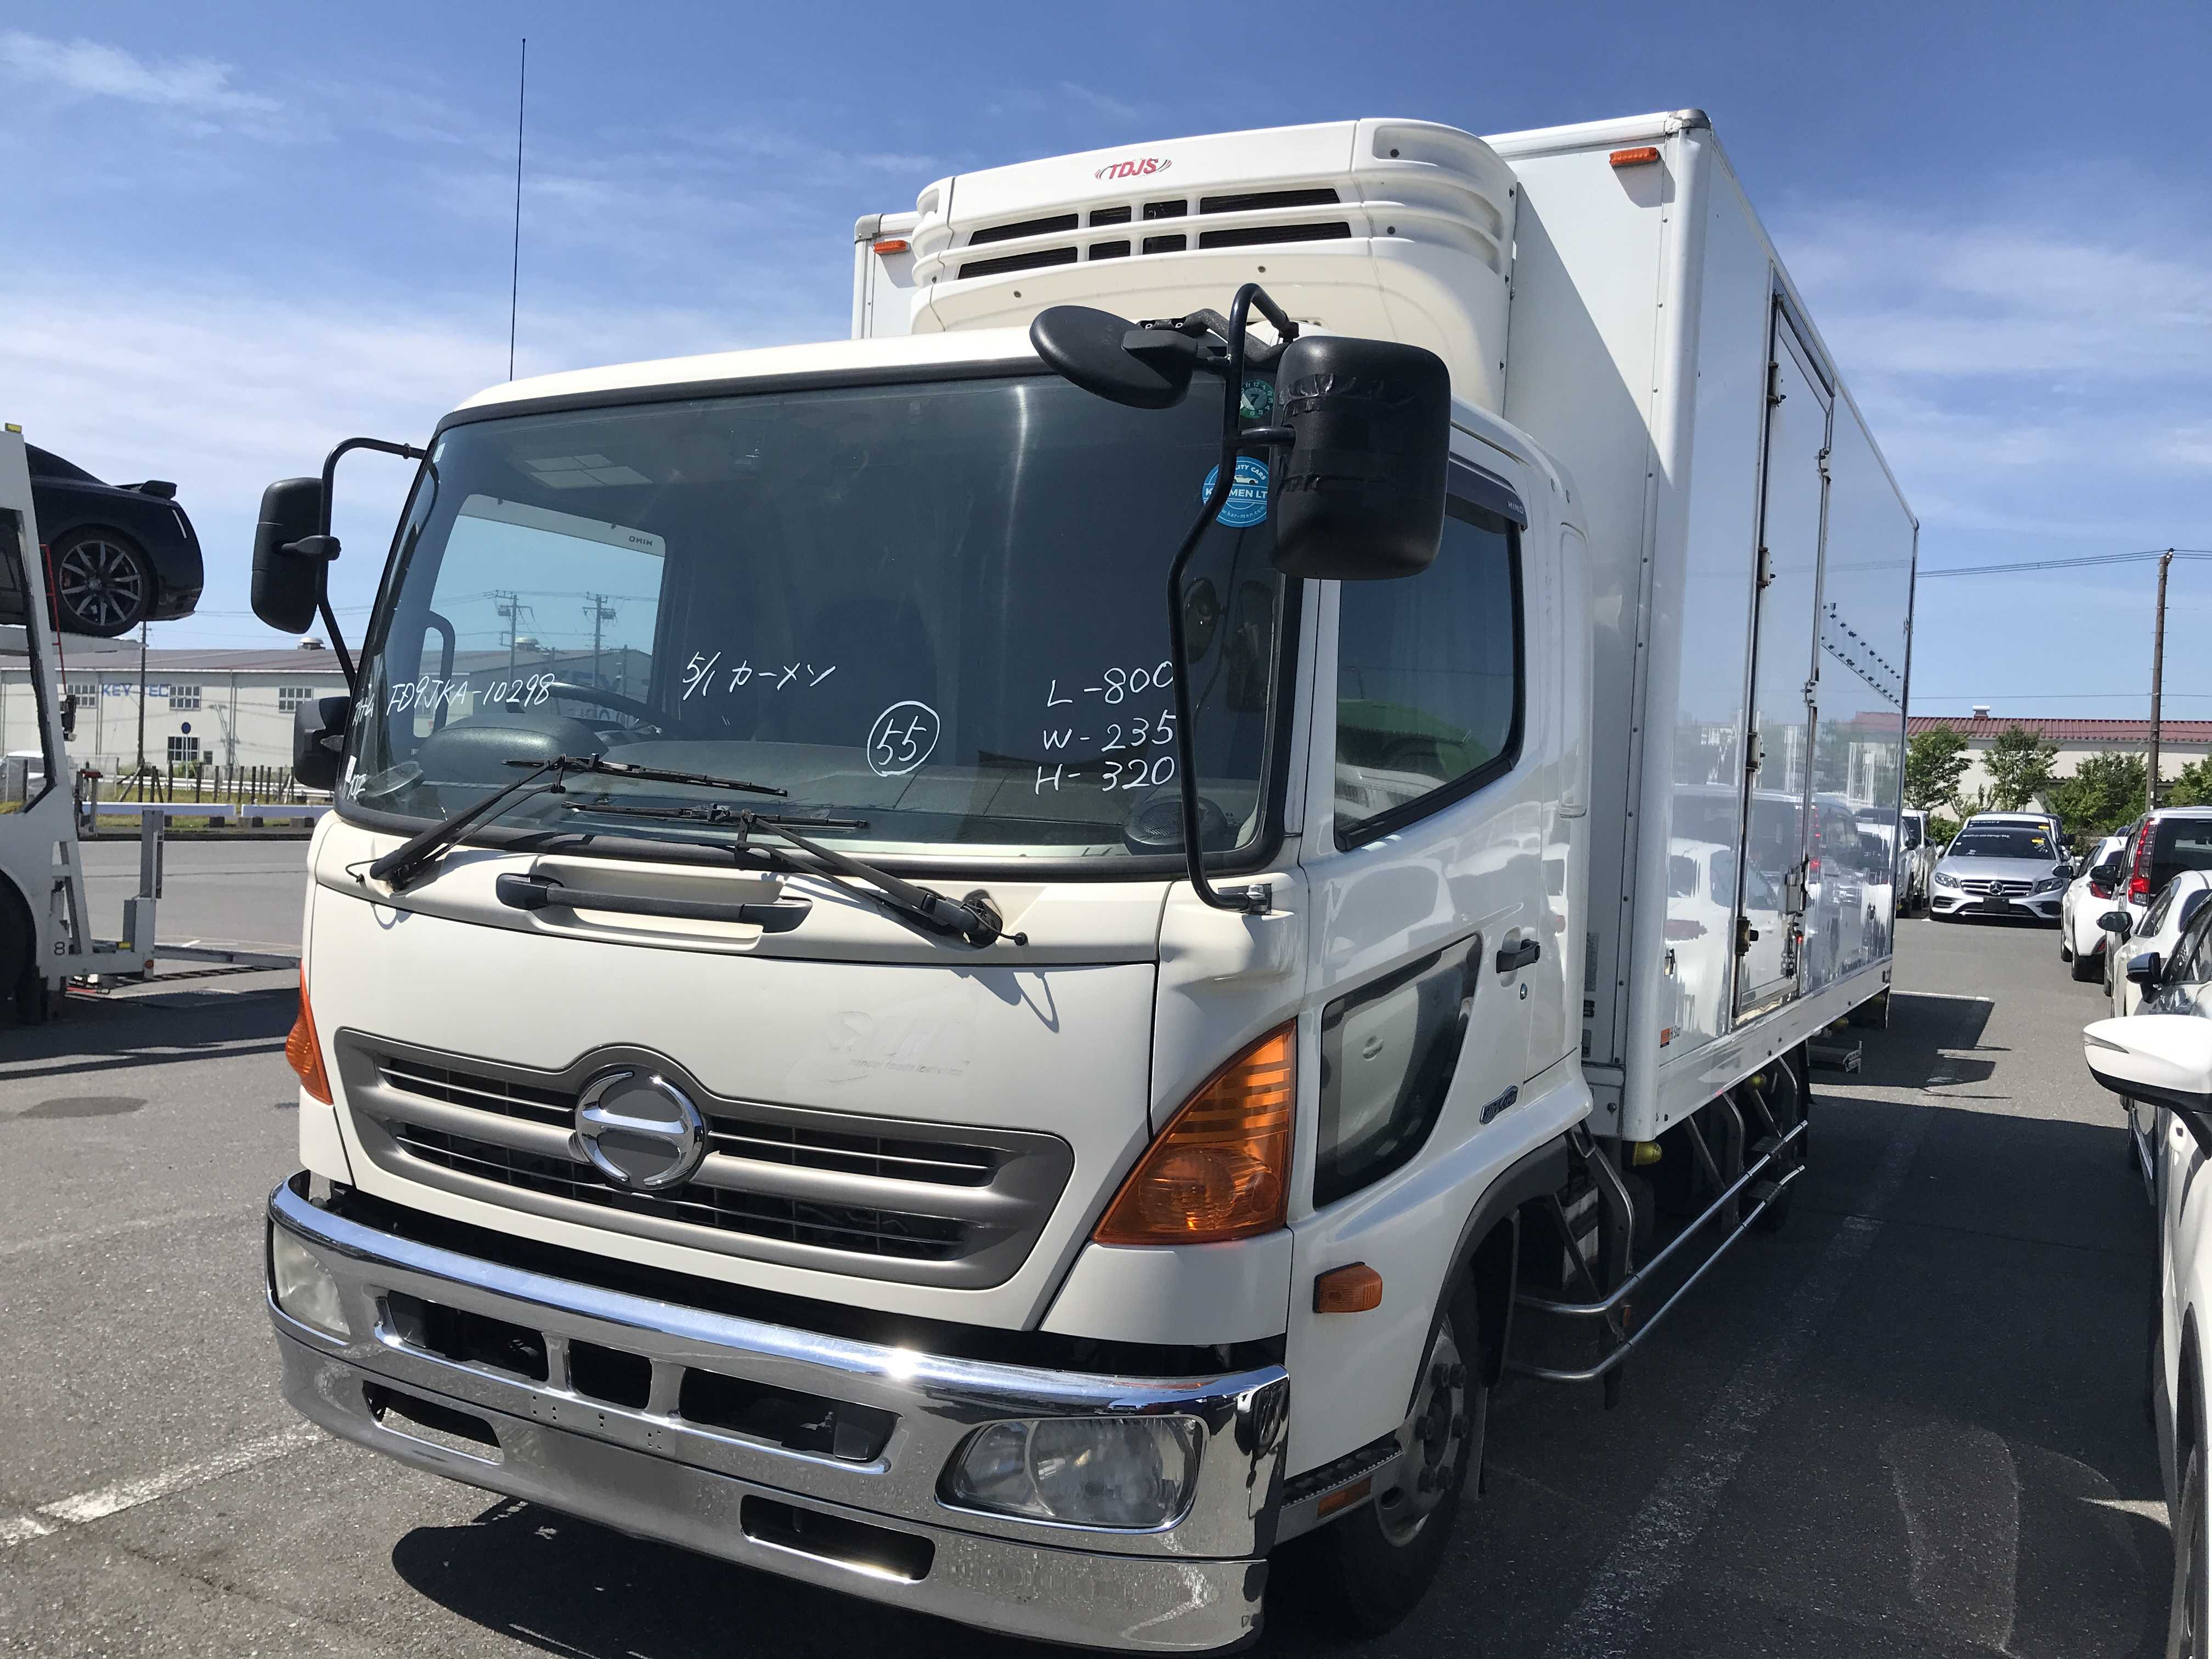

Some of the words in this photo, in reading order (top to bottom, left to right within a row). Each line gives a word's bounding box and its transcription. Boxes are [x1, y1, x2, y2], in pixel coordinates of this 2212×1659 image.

[1109, 158, 1159, 179] TDJS
[1251, 393, 1260, 405] 7
[1256, 490, 1268, 499] LT
[1508, 500, 1524, 515] HINO
[102, 683, 133, 697] KEY
[876, 715, 927, 766] 55
[54, 941, 65, 956] 8
